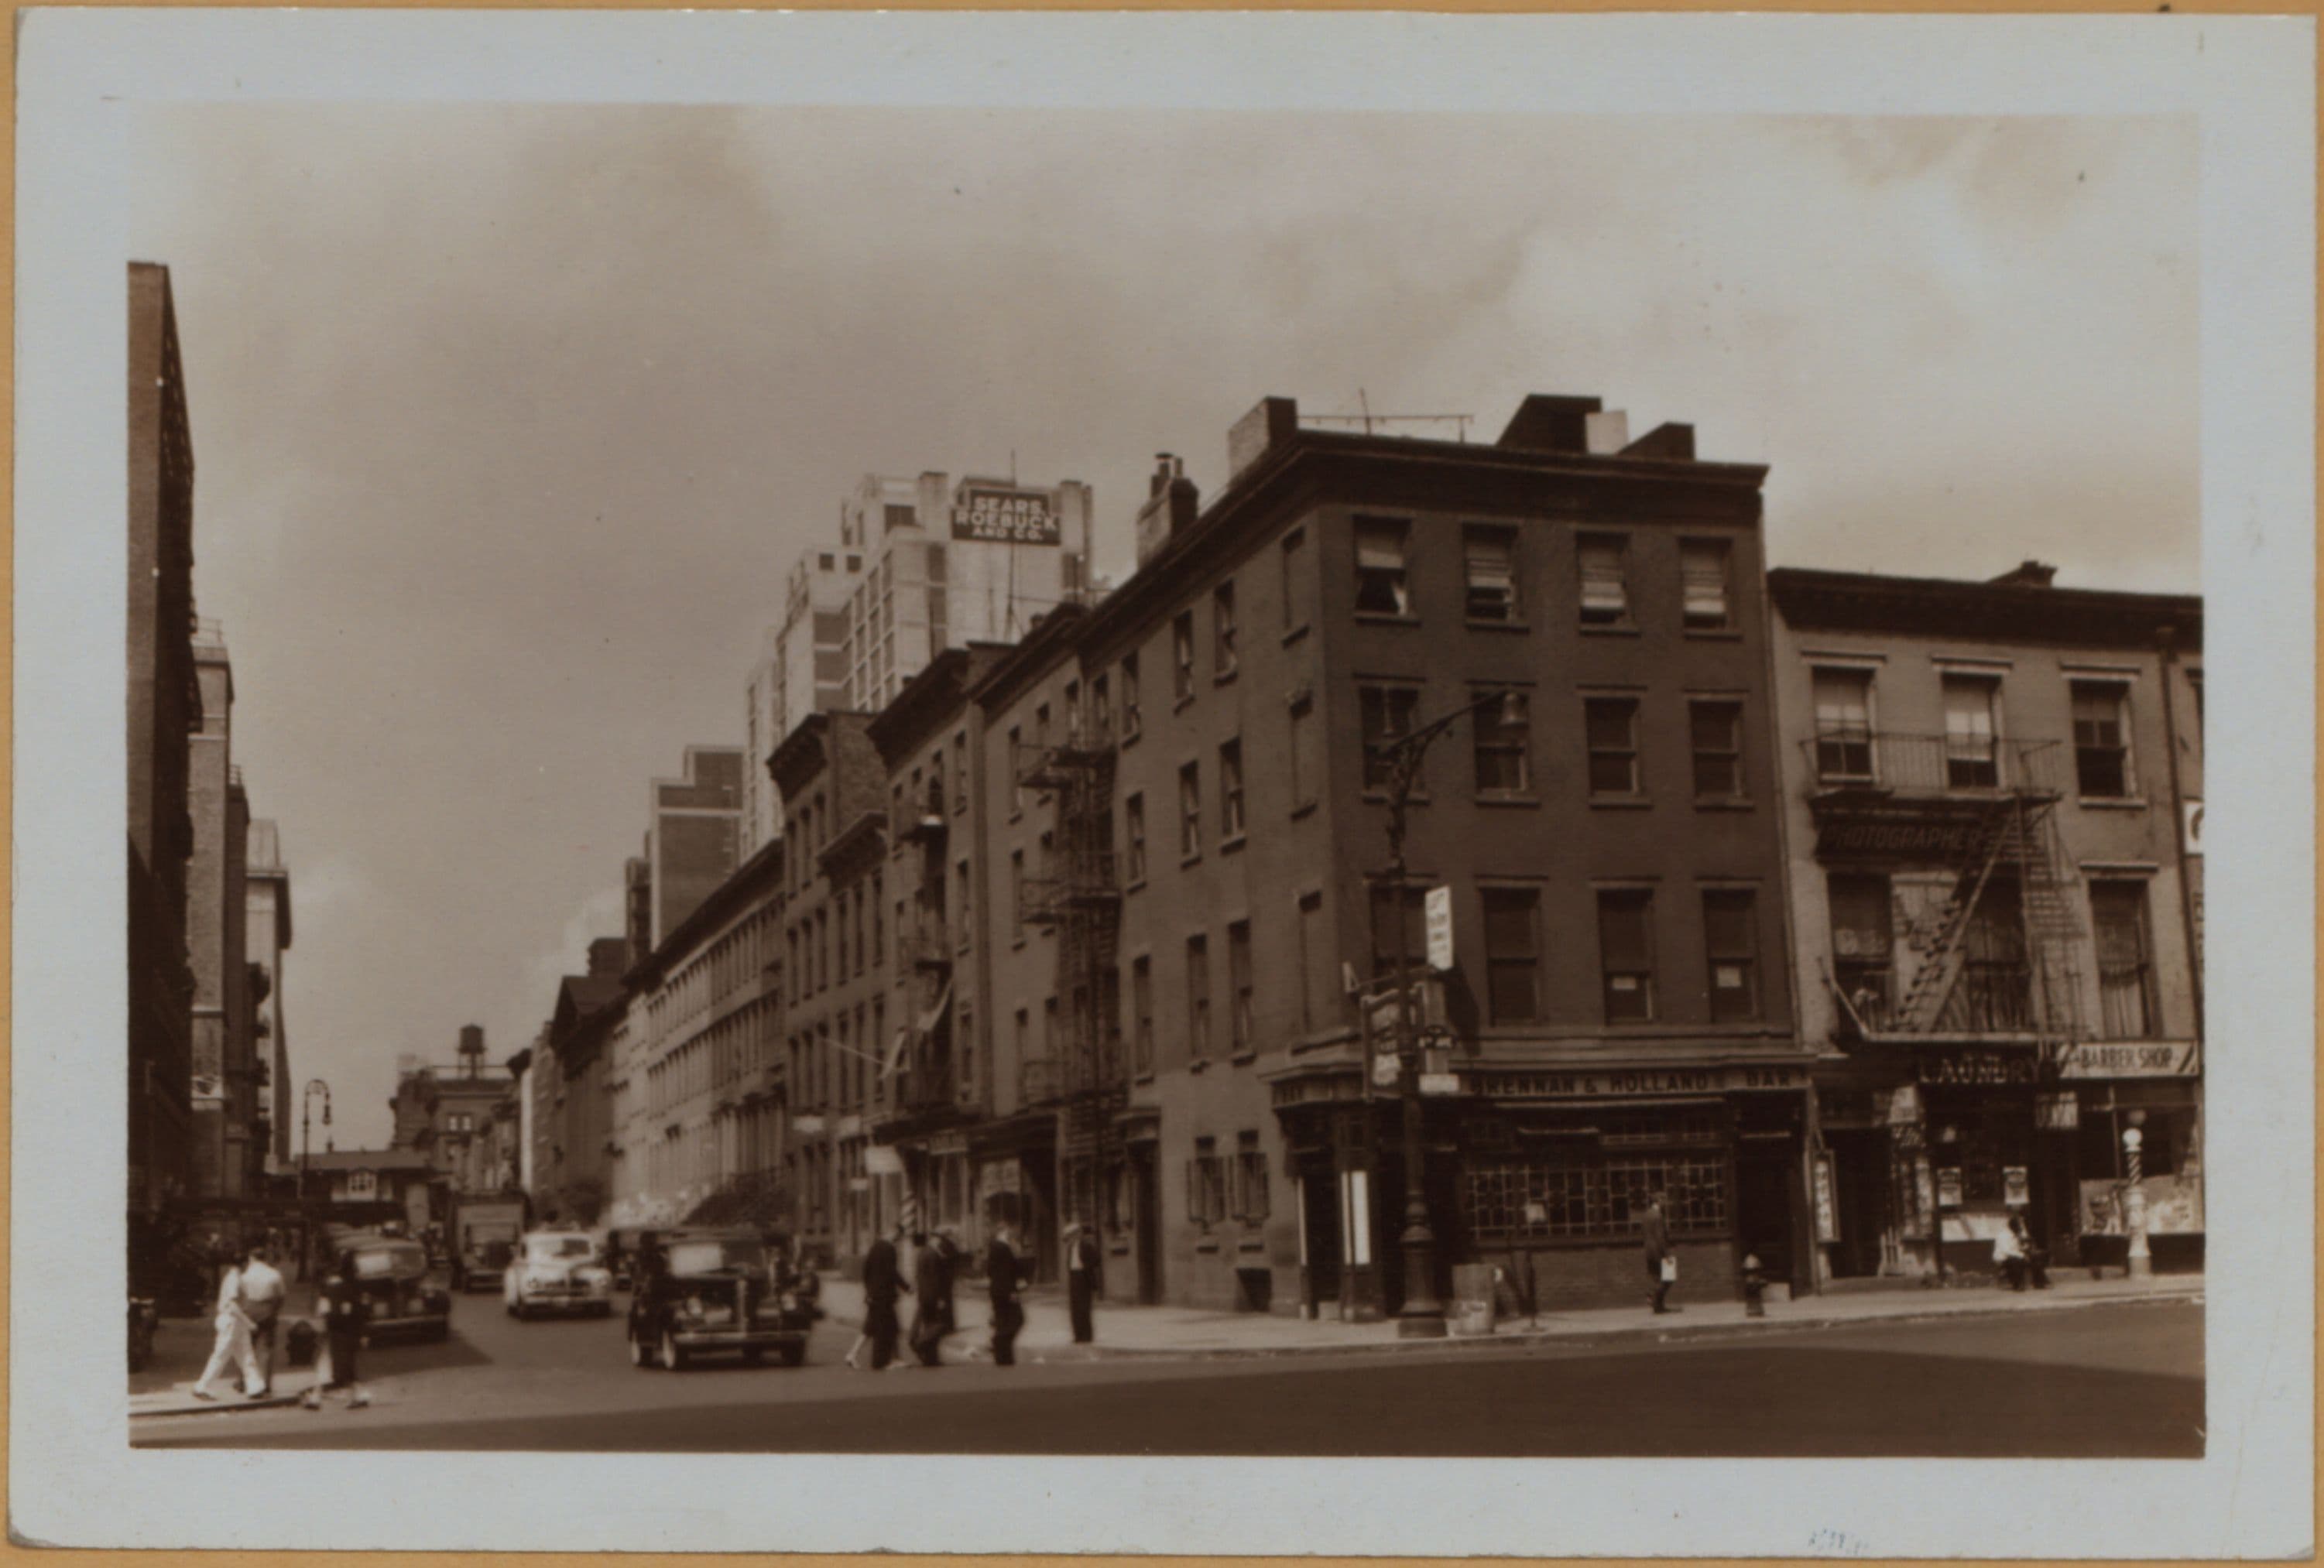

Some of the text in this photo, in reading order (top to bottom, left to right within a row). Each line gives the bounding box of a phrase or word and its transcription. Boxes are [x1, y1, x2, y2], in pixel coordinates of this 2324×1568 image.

[974, 496, 1042, 514] SEARS
[955, 511, 1058, 530] ROEBUCK
[972, 527, 1043, 540] AND CO.
[2080, 1046, 2173, 1068] BARBER SHOP
[1918, 1053, 2040, 1084] LAUNDRY
[1746, 1070, 1791, 1087] BAR
